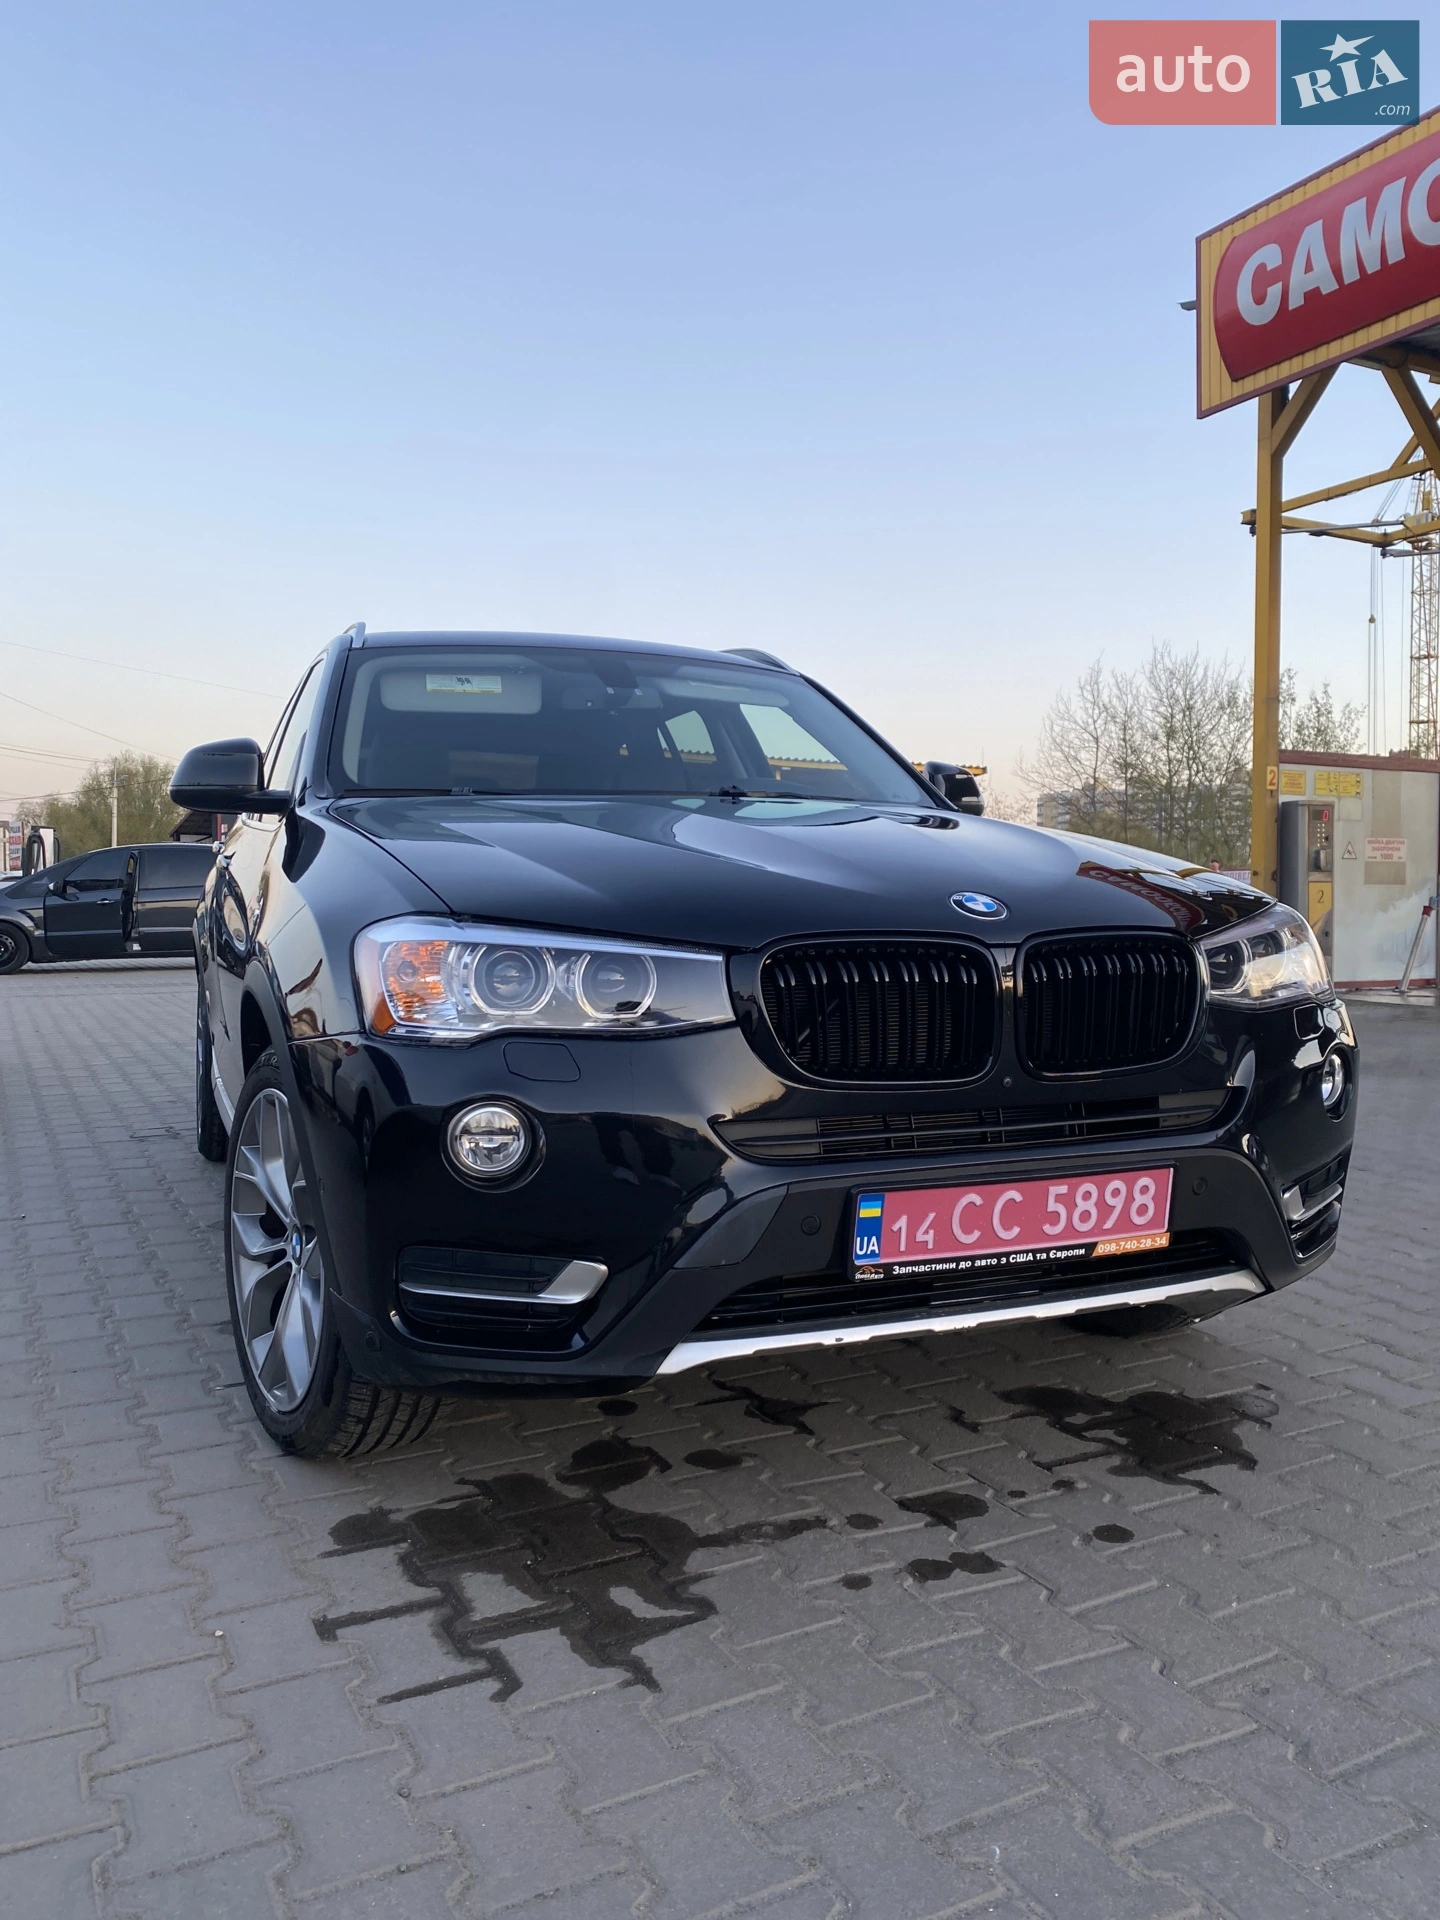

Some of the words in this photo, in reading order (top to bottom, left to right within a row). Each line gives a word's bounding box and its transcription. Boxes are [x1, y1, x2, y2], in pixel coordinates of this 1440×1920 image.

[1268, 769, 1277, 787] 2
[1317, 889, 1325, 904] 2
[891, 1212, 936, 1252] 14
[1042, 1177, 1157, 1236] 5898
[855, 1236, 880, 1256] UA
[1097, 1236, 1168, 1254] 098-740-28-34
[892, 1261, 957, 1275] Запчастини
[958, 1260, 972, 1270] до
[974, 1257, 998, 1267] авто
[1009, 1251, 1034, 1264] США
[1036, 1252, 1047, 1261] та
[1049, 1247, 1086, 1260] Європи
